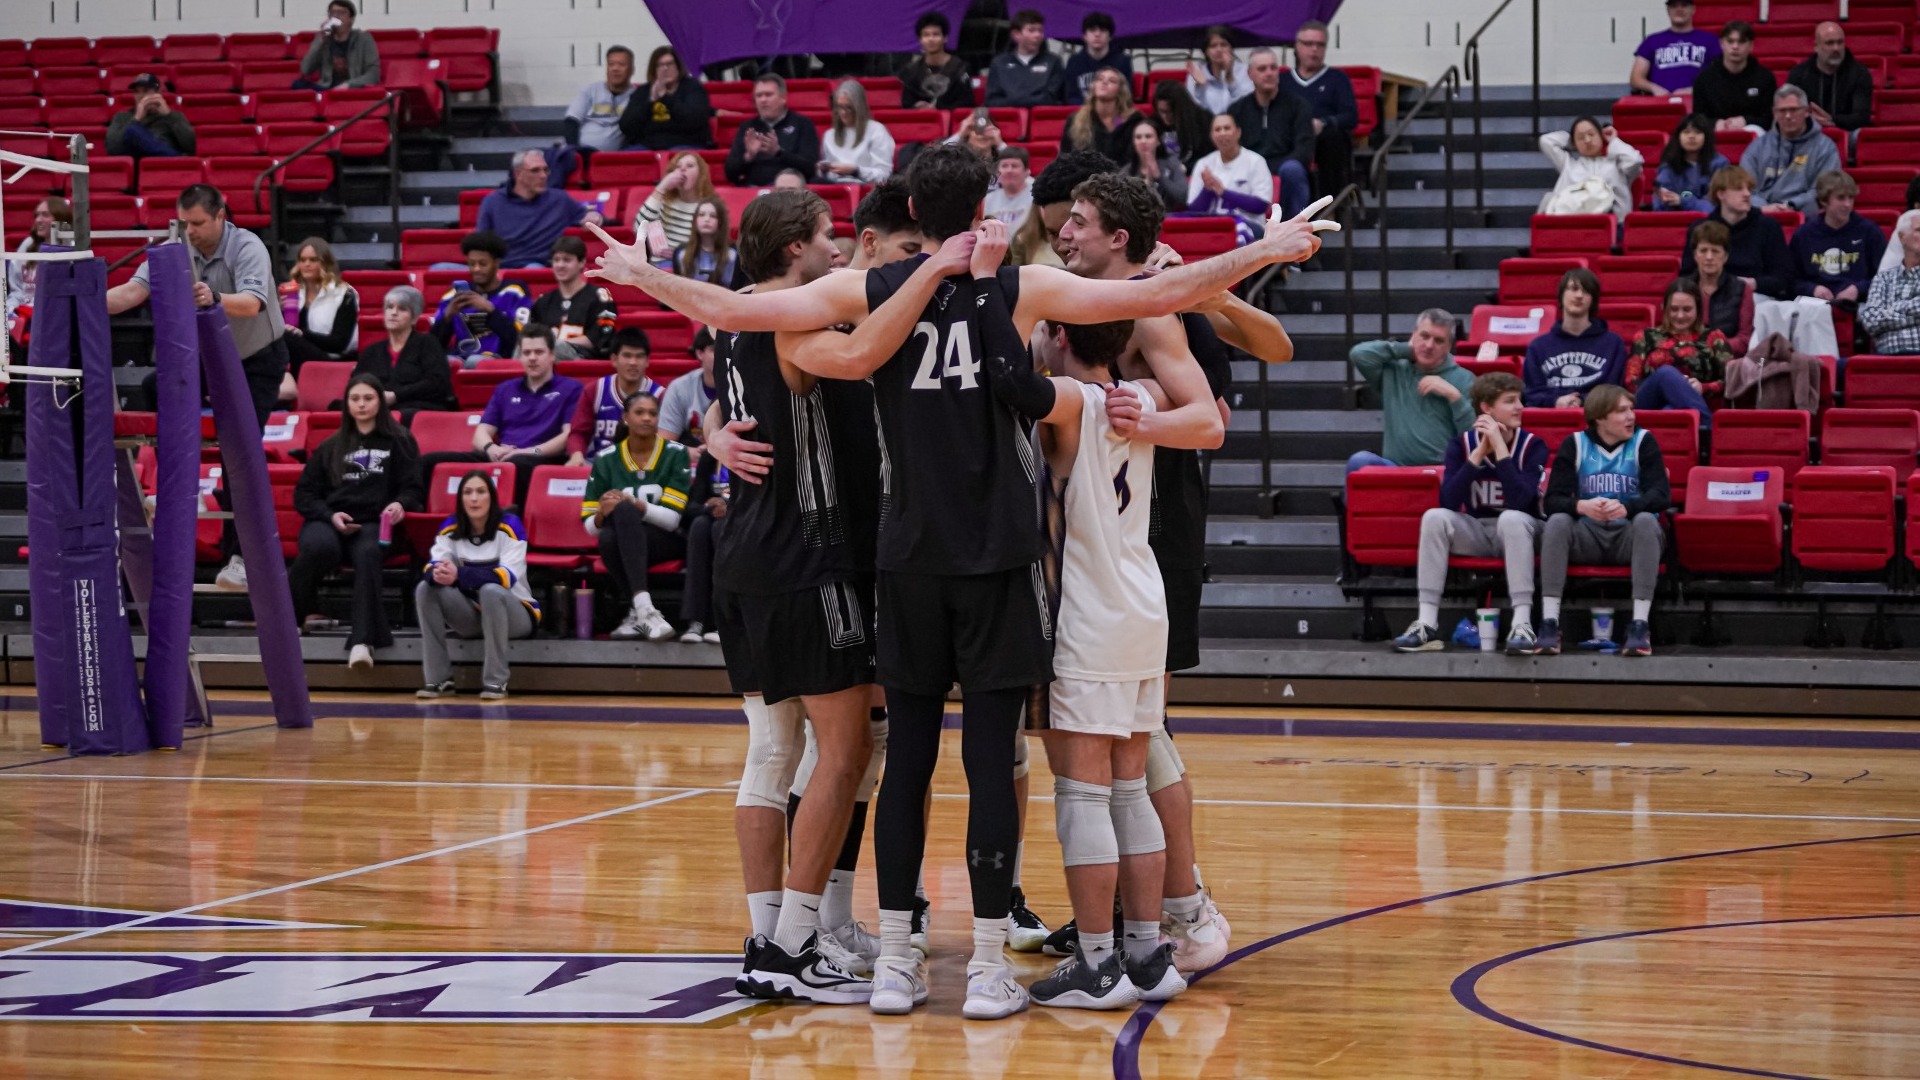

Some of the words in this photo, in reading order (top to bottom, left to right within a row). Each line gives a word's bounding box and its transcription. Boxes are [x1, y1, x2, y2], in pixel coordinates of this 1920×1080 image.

[1654, 46, 1689, 63] PURPLE
[1691, 45, 1707, 62] PIT
[911, 321, 981, 390] 24
[1234, 393, 1243, 406] F
[1581, 472, 1637, 493] HORNETS
[15, 604, 24, 616] B
[1298, 619, 1309, 633] B
[1283, 683, 1295, 697] A
